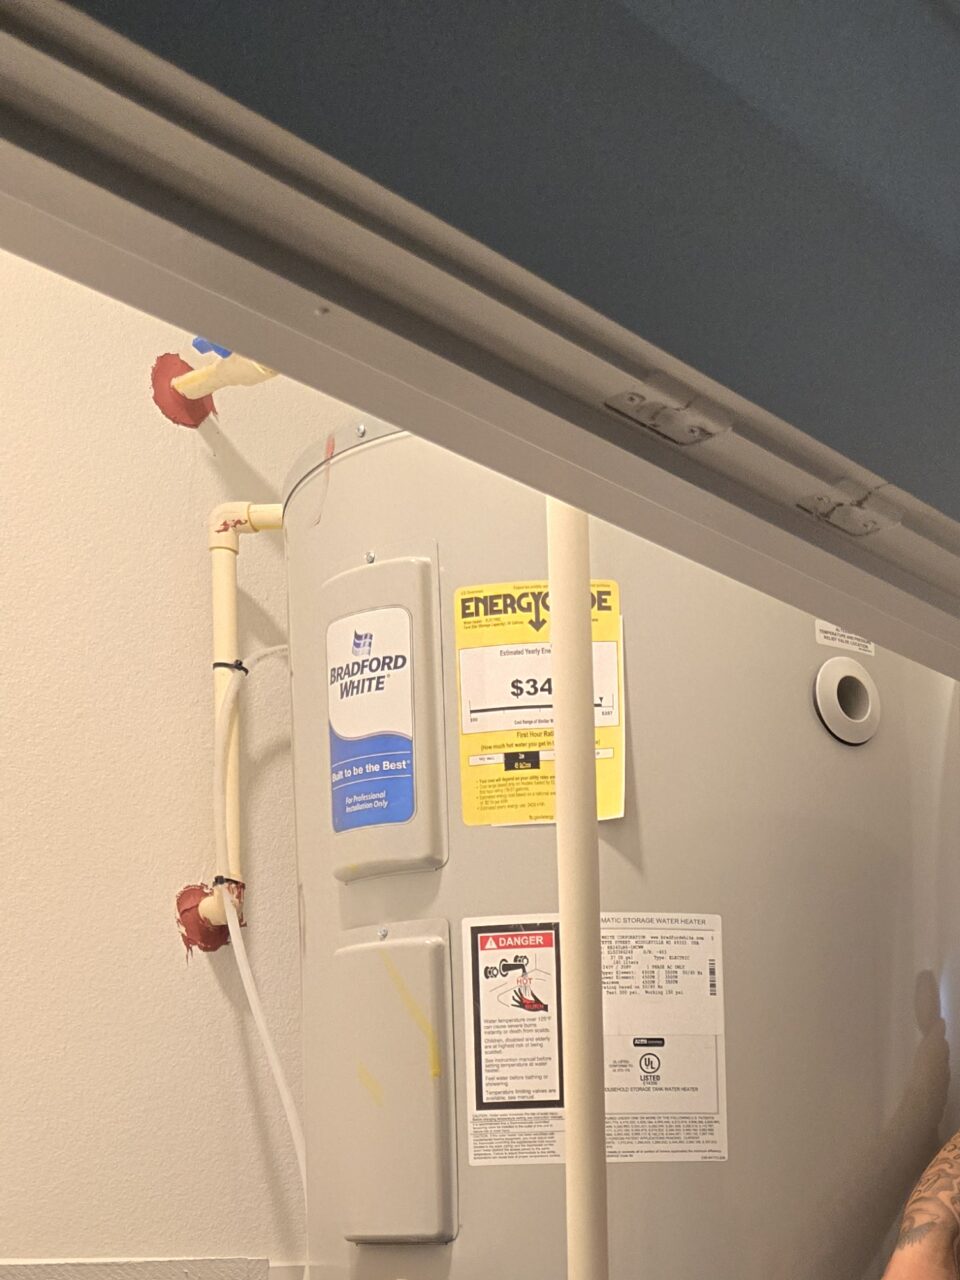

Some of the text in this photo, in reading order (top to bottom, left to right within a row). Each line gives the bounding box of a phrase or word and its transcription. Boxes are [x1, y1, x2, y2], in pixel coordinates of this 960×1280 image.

[330, 655, 407, 685] BRADFORD
[340, 675, 385, 699] WHITE
[511, 678, 552, 698] $34
[345, 769, 351, 777] to
[353, 766, 363, 775] be
[366, 763, 380, 772] the
[382, 760, 406, 770] Best
[353, 790, 386, 802] Professional
[374, 800, 388, 808] Only
[499, 936, 543, 947] DANGER
[644, 1057, 655, 1069] UL
